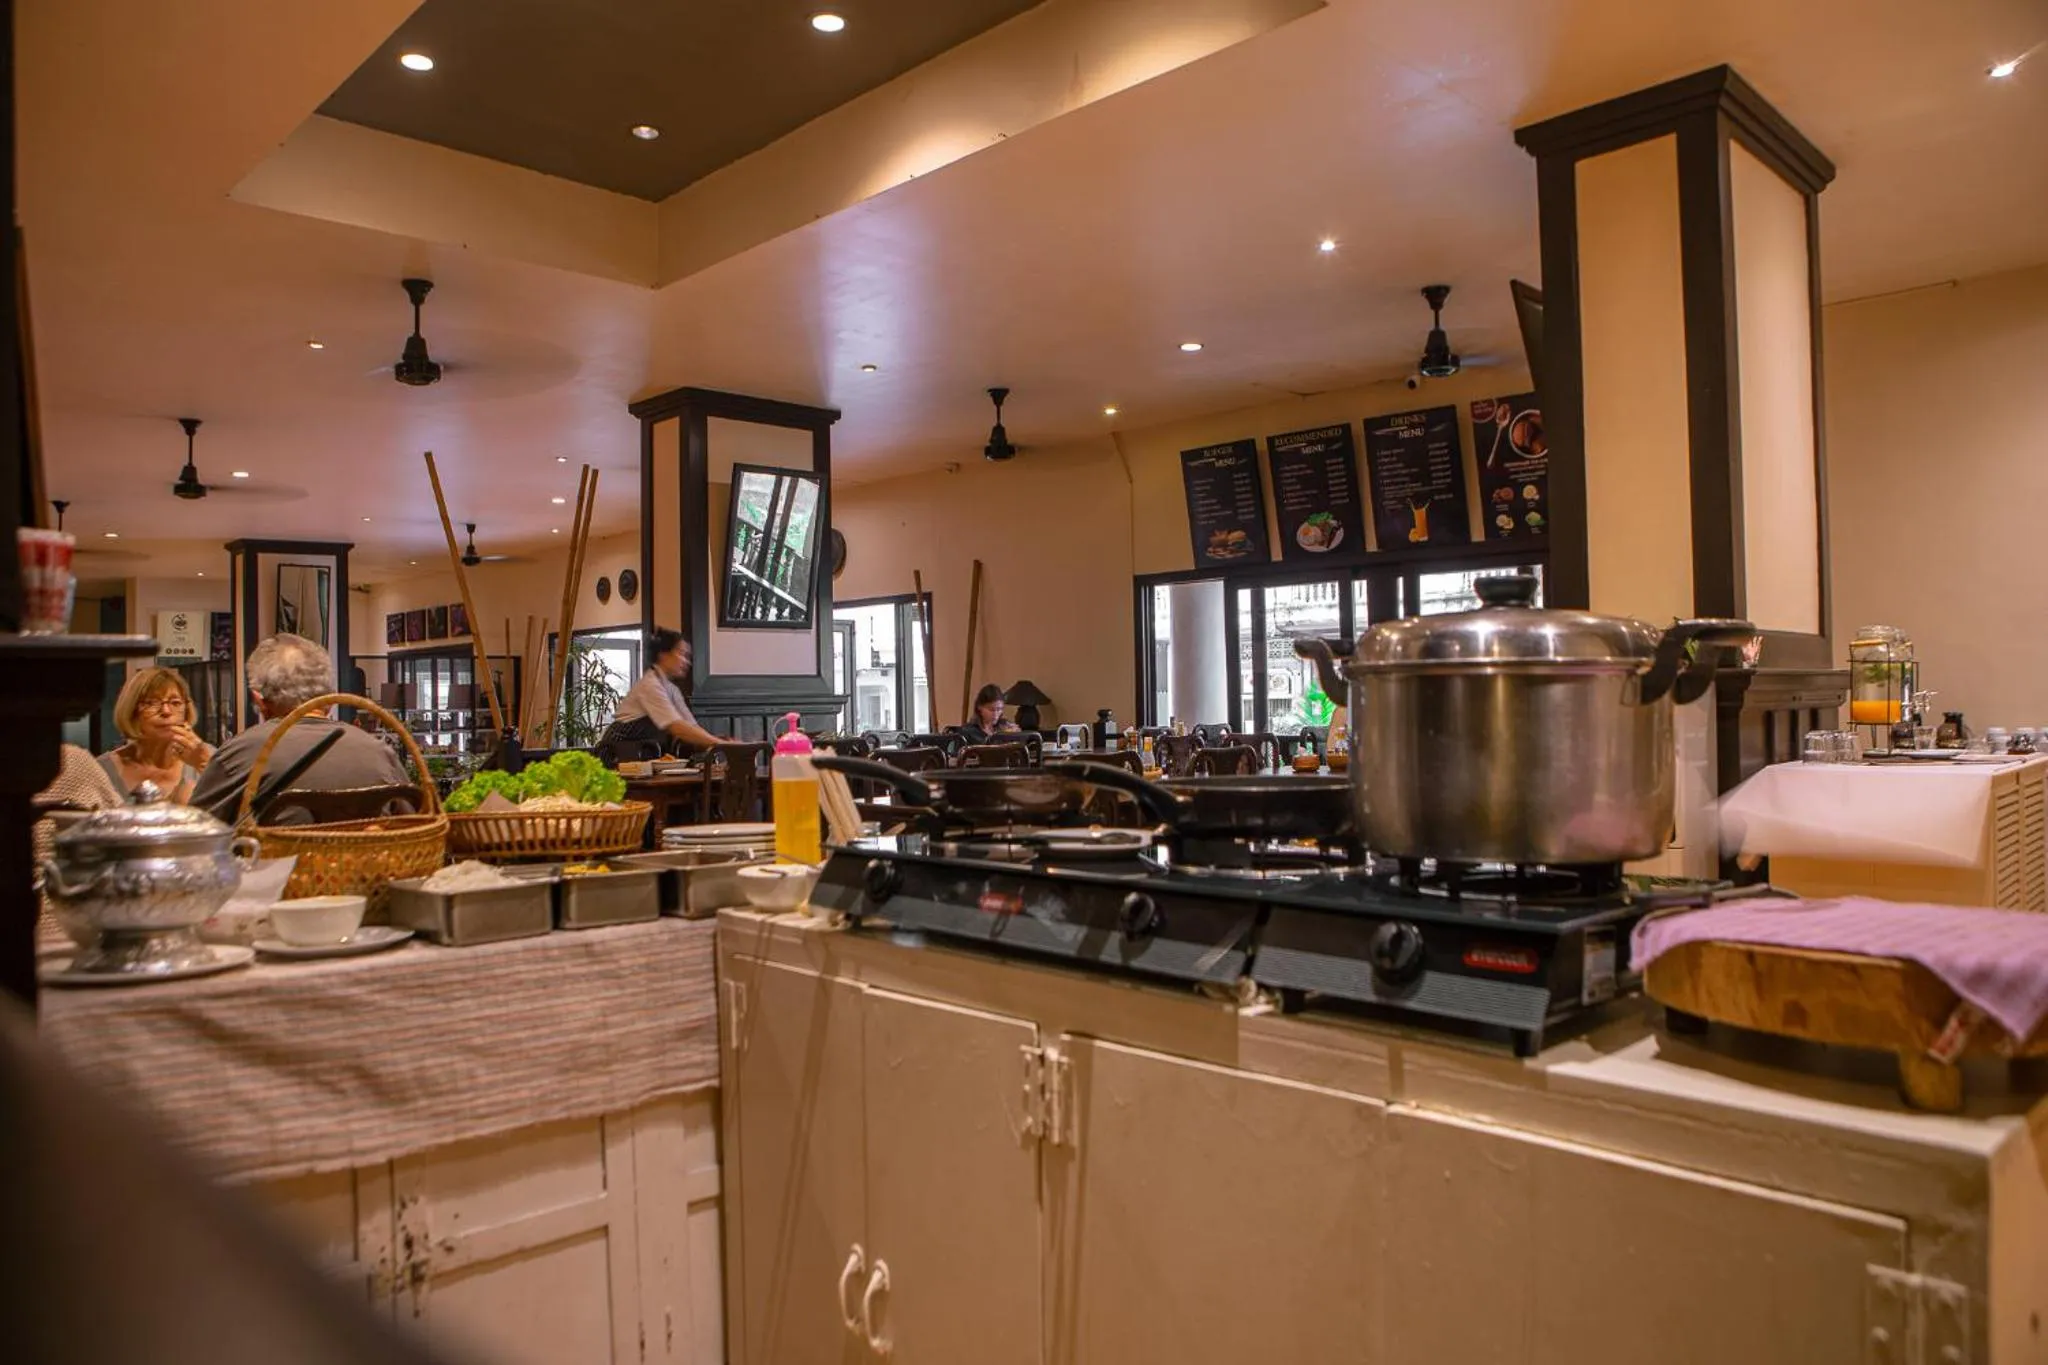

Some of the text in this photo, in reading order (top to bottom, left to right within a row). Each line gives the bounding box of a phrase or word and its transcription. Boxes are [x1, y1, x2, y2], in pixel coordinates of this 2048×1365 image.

[1399, 427, 1425, 440] MENU
[1302, 444, 1326, 454] MENU
[1214, 457, 1235, 468] MENU
